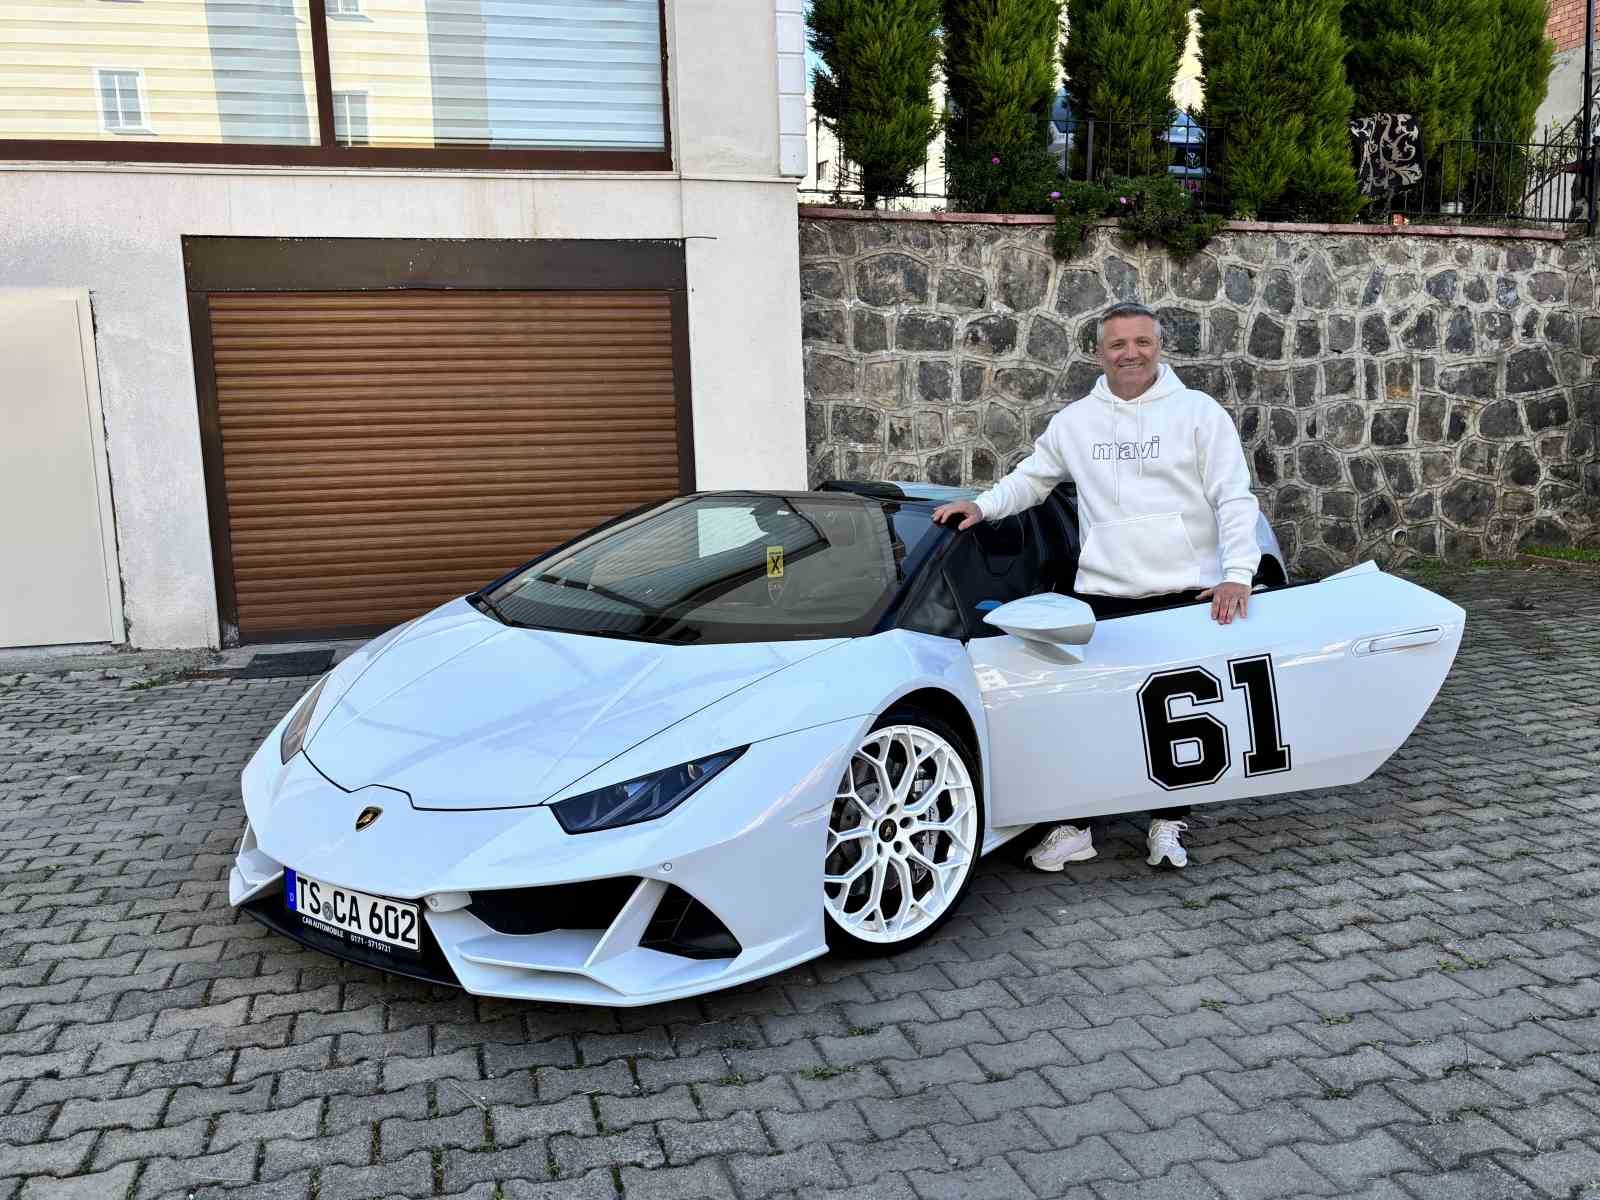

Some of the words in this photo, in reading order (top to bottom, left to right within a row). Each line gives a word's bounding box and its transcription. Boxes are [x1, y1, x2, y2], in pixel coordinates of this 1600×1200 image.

[1092, 435, 1160, 460] mavi
[1136, 652, 1292, 791] 61
[297, 876, 321, 915] TS
[333, 890, 362, 930] CA
[370, 901, 417, 945] 602
[313, 920, 344, 938] AUTOMOBILE
